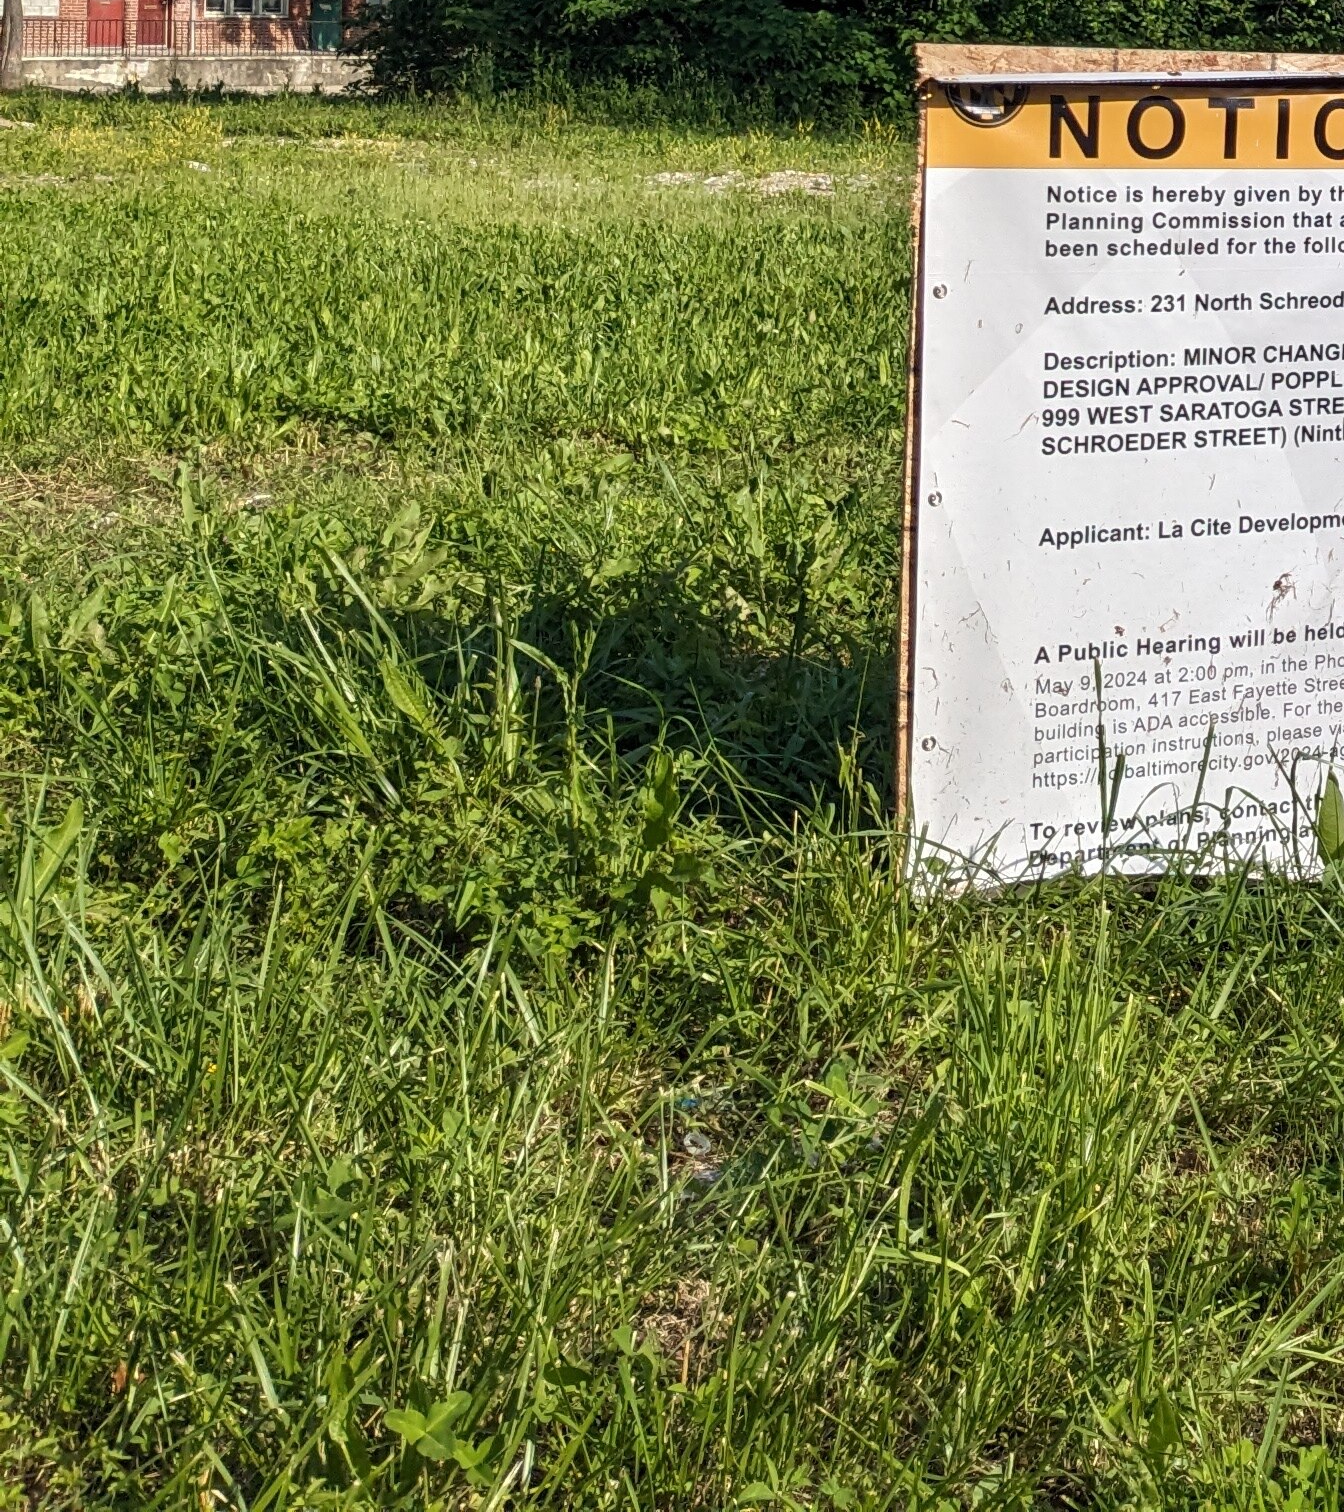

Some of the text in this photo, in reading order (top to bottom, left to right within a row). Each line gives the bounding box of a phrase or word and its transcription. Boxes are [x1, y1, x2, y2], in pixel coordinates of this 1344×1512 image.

[1047, 186, 1117, 203] Notice
[1126, 186, 1143, 202] is
[1152, 184, 1225, 207] hereby
[1234, 185, 1290, 207] given
[1299, 184, 1321, 206] by
[1046, 212, 1144, 233] Planning
[1152, 211, 1285, 228] Commission
[1293, 210, 1332, 227] that
[1045, 238, 1099, 257] been
[1107, 238, 1218, 256] scheduled
[1227, 237, 1255, 255] for
[1264, 237, 1295, 254] the
[1045, 296, 1143, 316] Address:
[1151, 296, 1186, 313] 231
[1195, 293, 1252, 312] North
[1045, 350, 1176, 375] Description:
[1184, 347, 1255, 367] MINOR
[1044, 379, 1129, 399] DESIGN
[1137, 372, 1264, 396] APPROVAL/
[1042, 408, 1079, 428] 999
[1086, 405, 1151, 425] WEST
[1159, 400, 1282, 422] SARATOGA
[1041, 434, 1186, 456] SCHROEDER
[1194, 429, 1287, 452] STREET)
[1039, 525, 1150, 549] Applicant:
[1158, 520, 1183, 540] La
[1191, 517, 1232, 538] Cite
[1034, 647, 1050, 664] A
[1059, 641, 1128, 662] Public
[1137, 636, 1221, 655] Hearing
[1230, 629, 1265, 648] will
[1274, 629, 1297, 644] be
[1035, 678, 1073, 695] May
[1081, 676, 1097, 691] 9,
[1104, 671, 1147, 688] 2024
[1154, 669, 1171, 683] at
[1179, 665, 1216, 683] 2:00
[1224, 664, 1254, 681] pm,
[1261, 662, 1275, 674] in
[1282, 657, 1307, 672] the
[1035, 695, 1141, 718] Boardroom,
[1148, 692, 1181, 708] 417
[1189, 688, 1226, 705] East
[1233, 681, 1297, 702] Fayette
[1034, 722, 1104, 742] building
[1113, 719, 1128, 735] is
[1134, 715, 1173, 733] ADA
[1179, 705, 1275, 728] accessible.
[1284, 702, 1311, 718] For
[1317, 699, 1343, 714] the
[1034, 742, 1146, 768] participation
[1152, 730, 1260, 753] instructions,
[1268, 723, 1322, 744] please
[1030, 822, 1056, 840] To
